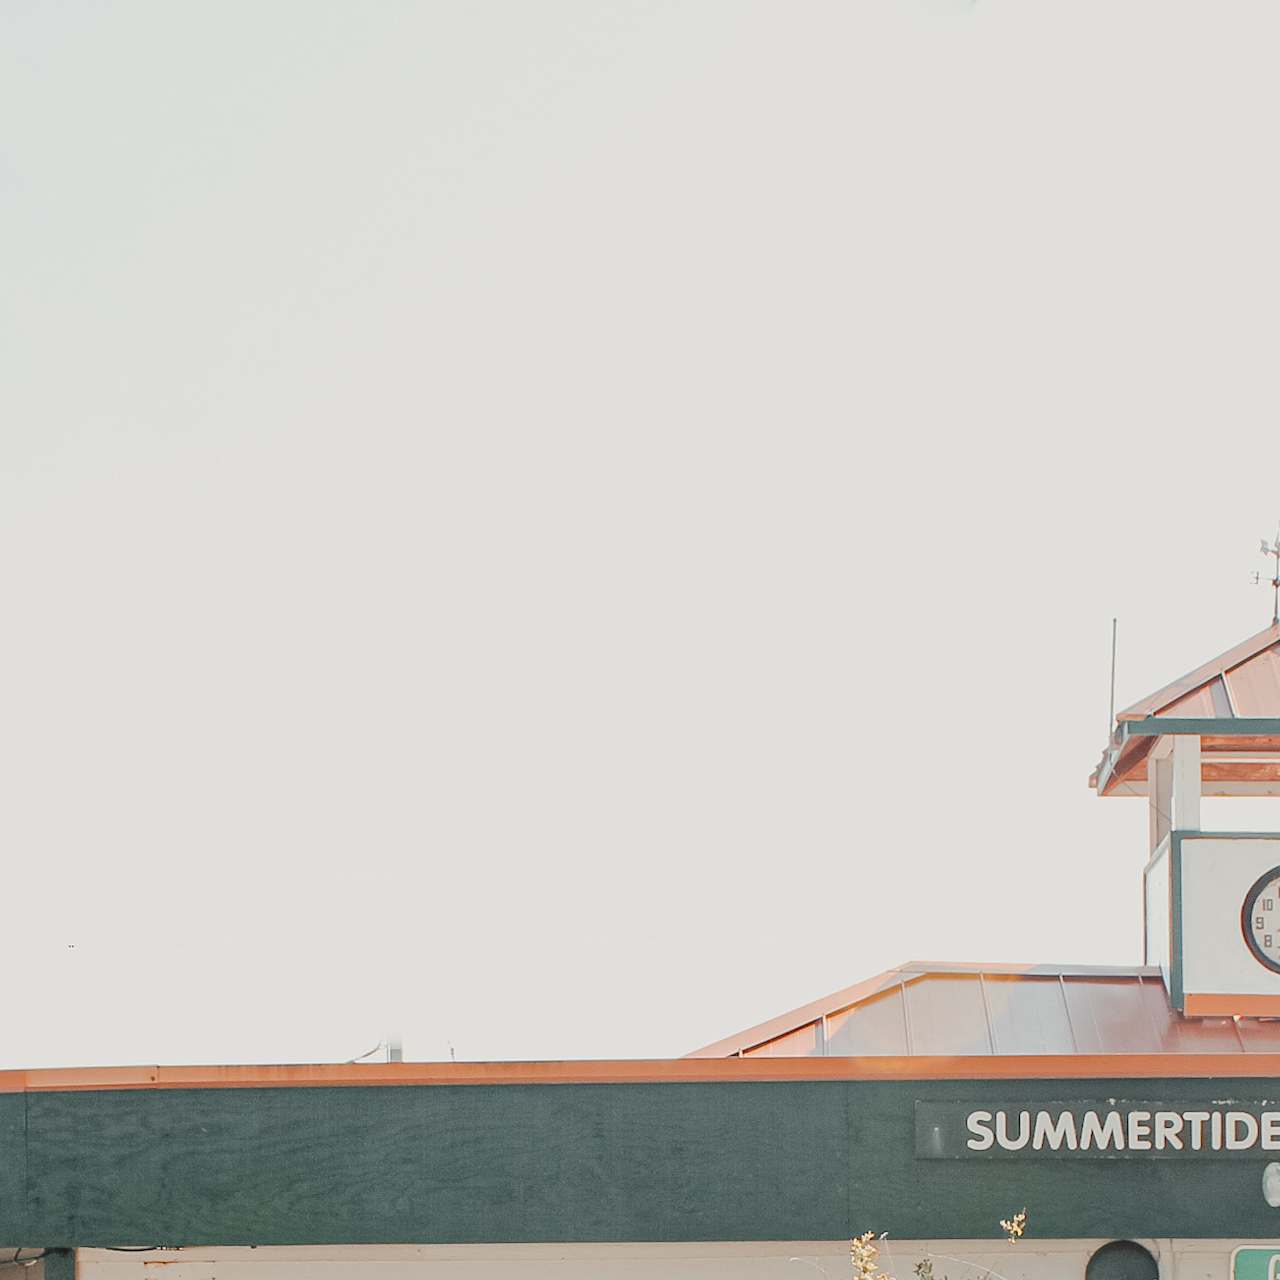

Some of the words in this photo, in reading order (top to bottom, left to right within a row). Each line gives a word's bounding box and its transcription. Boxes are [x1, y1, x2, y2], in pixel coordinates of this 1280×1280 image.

[1262, 898, 1273, 911] 10
[1255, 917, 1264, 930] 9
[1264, 935, 1273, 948] 8
